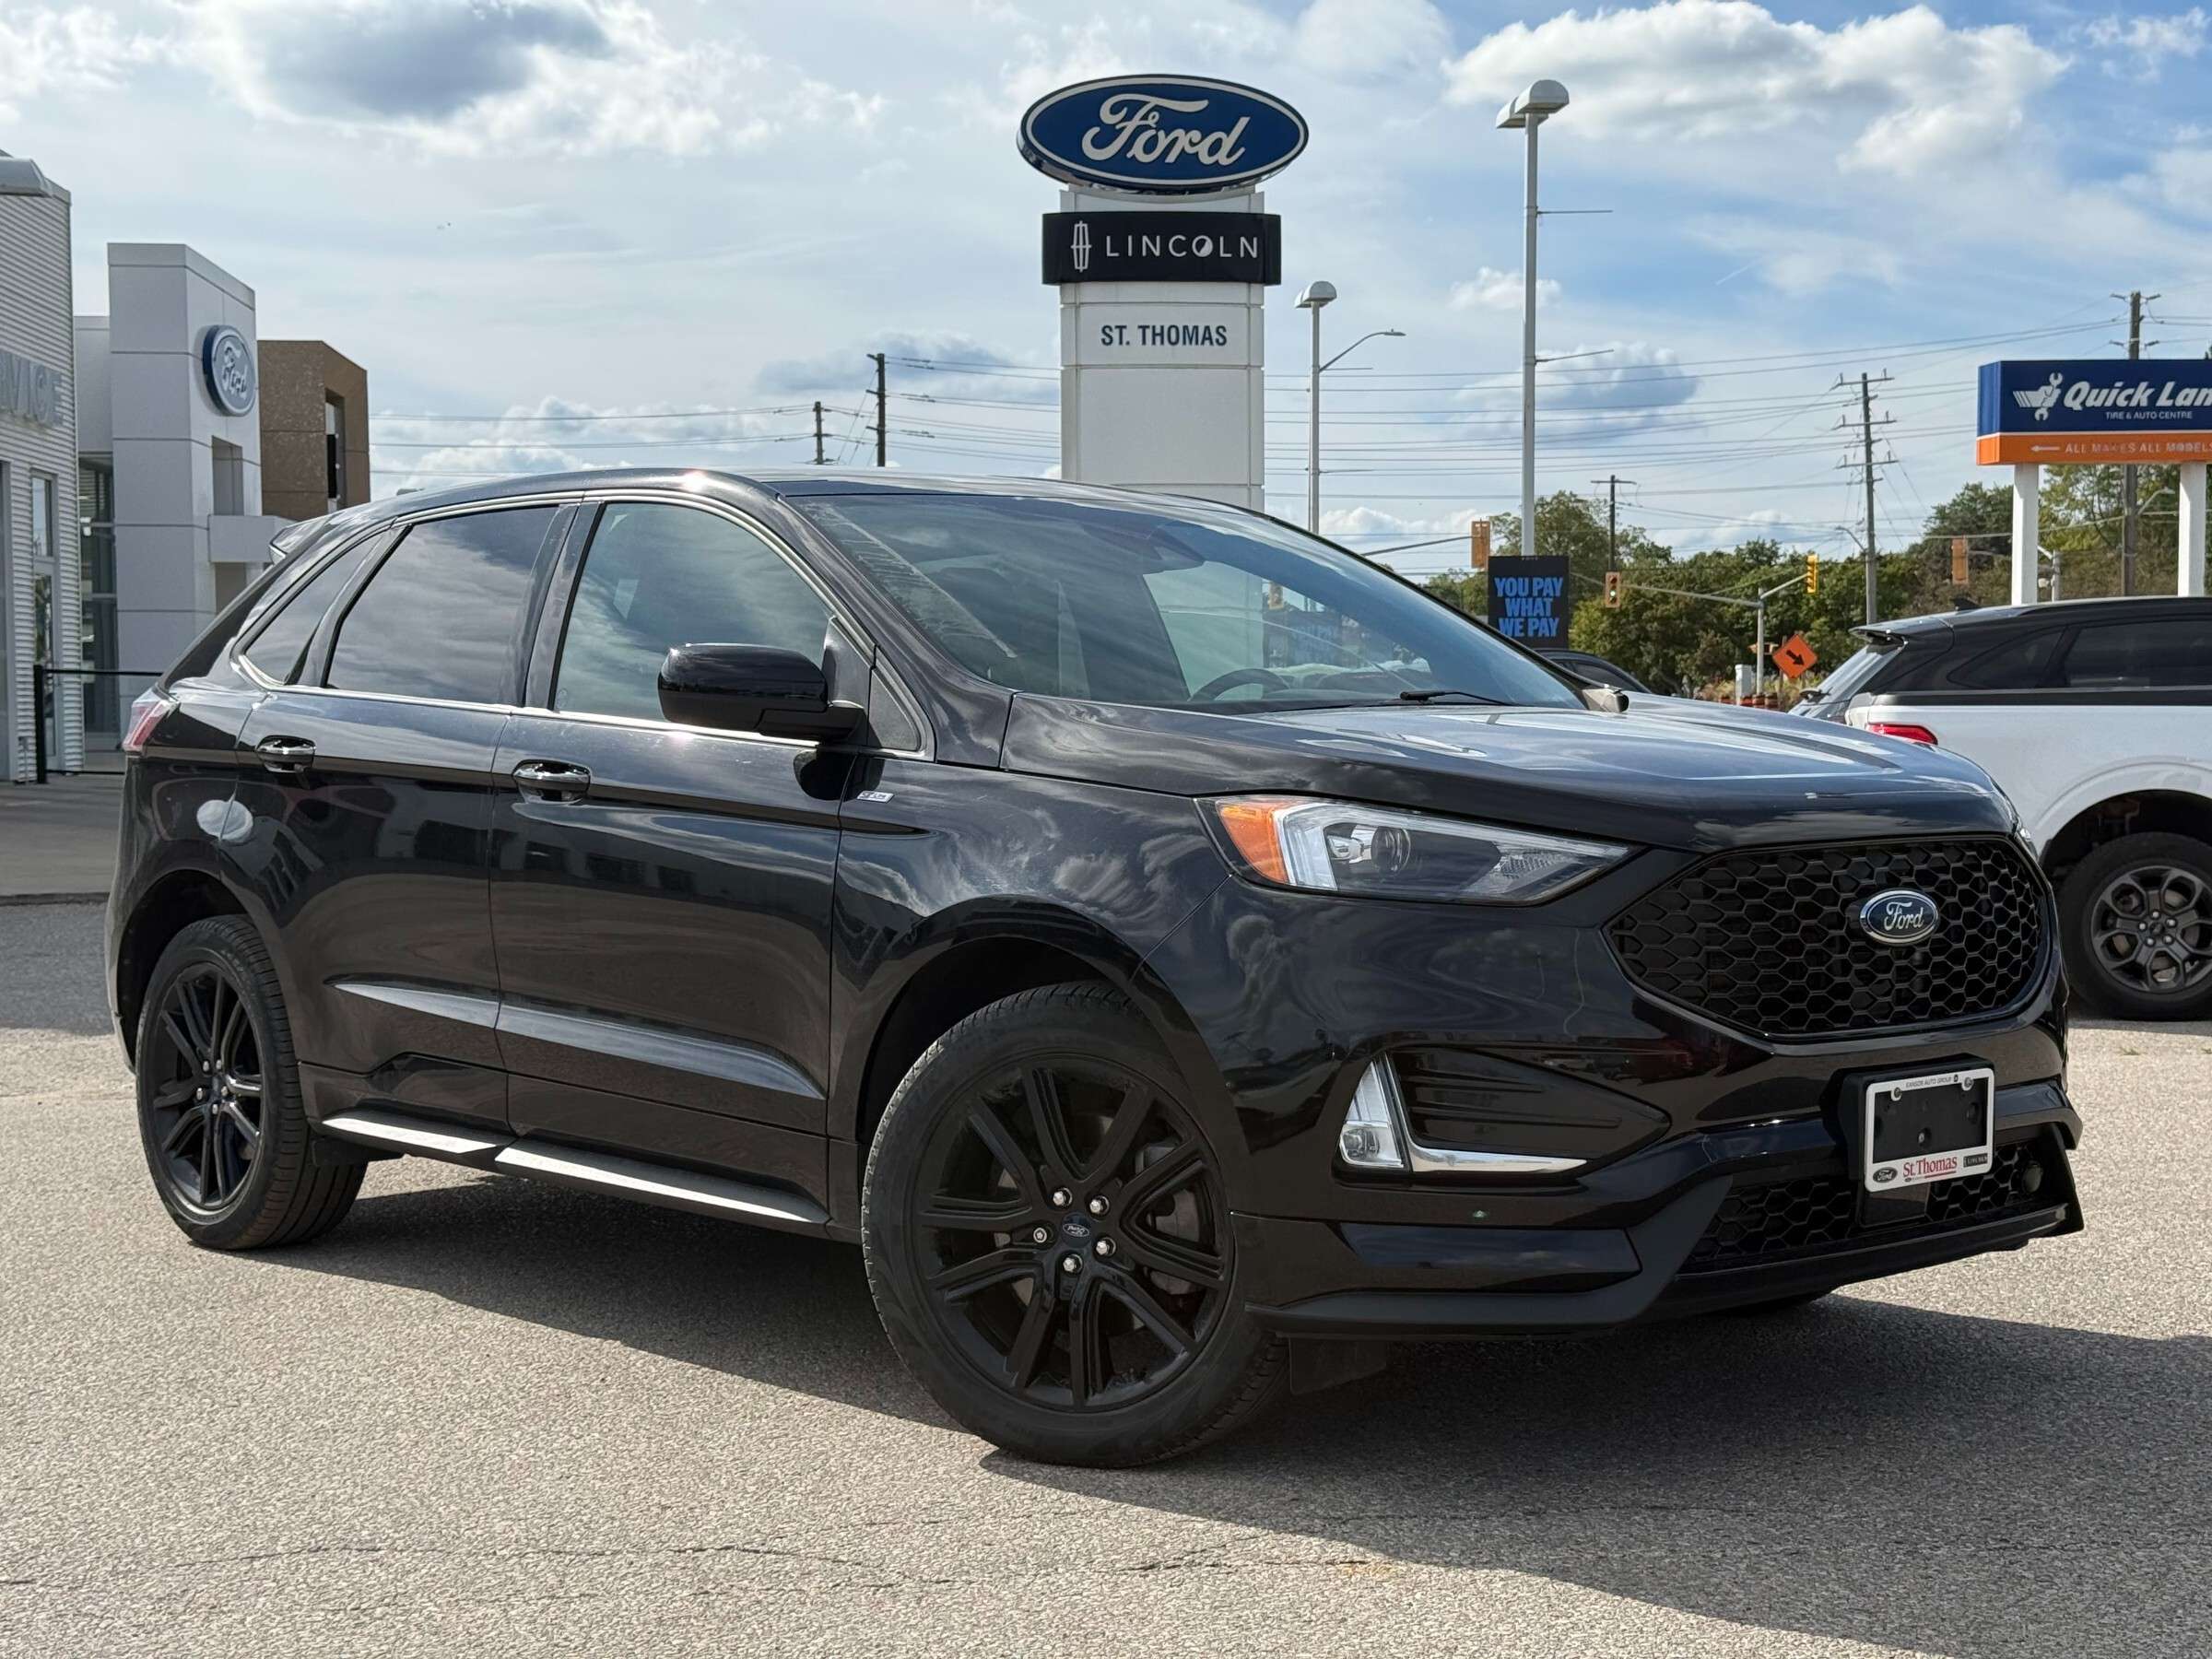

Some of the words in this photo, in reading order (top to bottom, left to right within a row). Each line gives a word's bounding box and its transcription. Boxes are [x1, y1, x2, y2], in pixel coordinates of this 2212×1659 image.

[1081, 93, 1251, 166] Ford
[1106, 235, 1258, 258] LINCOLN
[1100, 324, 1131, 347] ST.
[1137, 324, 1228, 347] THOMAS
[222, 340, 248, 400] Ford
[2063, 380, 2155, 411] Quick
[2106, 411, 2124, 420] TIRE
[2126, 411, 2132, 420] &
[2134, 411, 2158, 419] AUTO
[2159, 411, 2193, 419] CENTRE
[2065, 442, 2087, 454] ALL
[2091, 442, 2137, 453] MAKES
[2139, 442, 2160, 453] ALL
[1494, 577, 1529, 597] YOU
[1533, 577, 1563, 597] PAY
[1505, 597, 1553, 617] WHAT
[1499, 618, 1524, 637] WE
[1527, 618, 1559, 637] PAY
[1884, 901, 1924, 931] Ford
[1903, 1162, 1916, 1178] St.
[1917, 1157, 1958, 1174] Thomas
